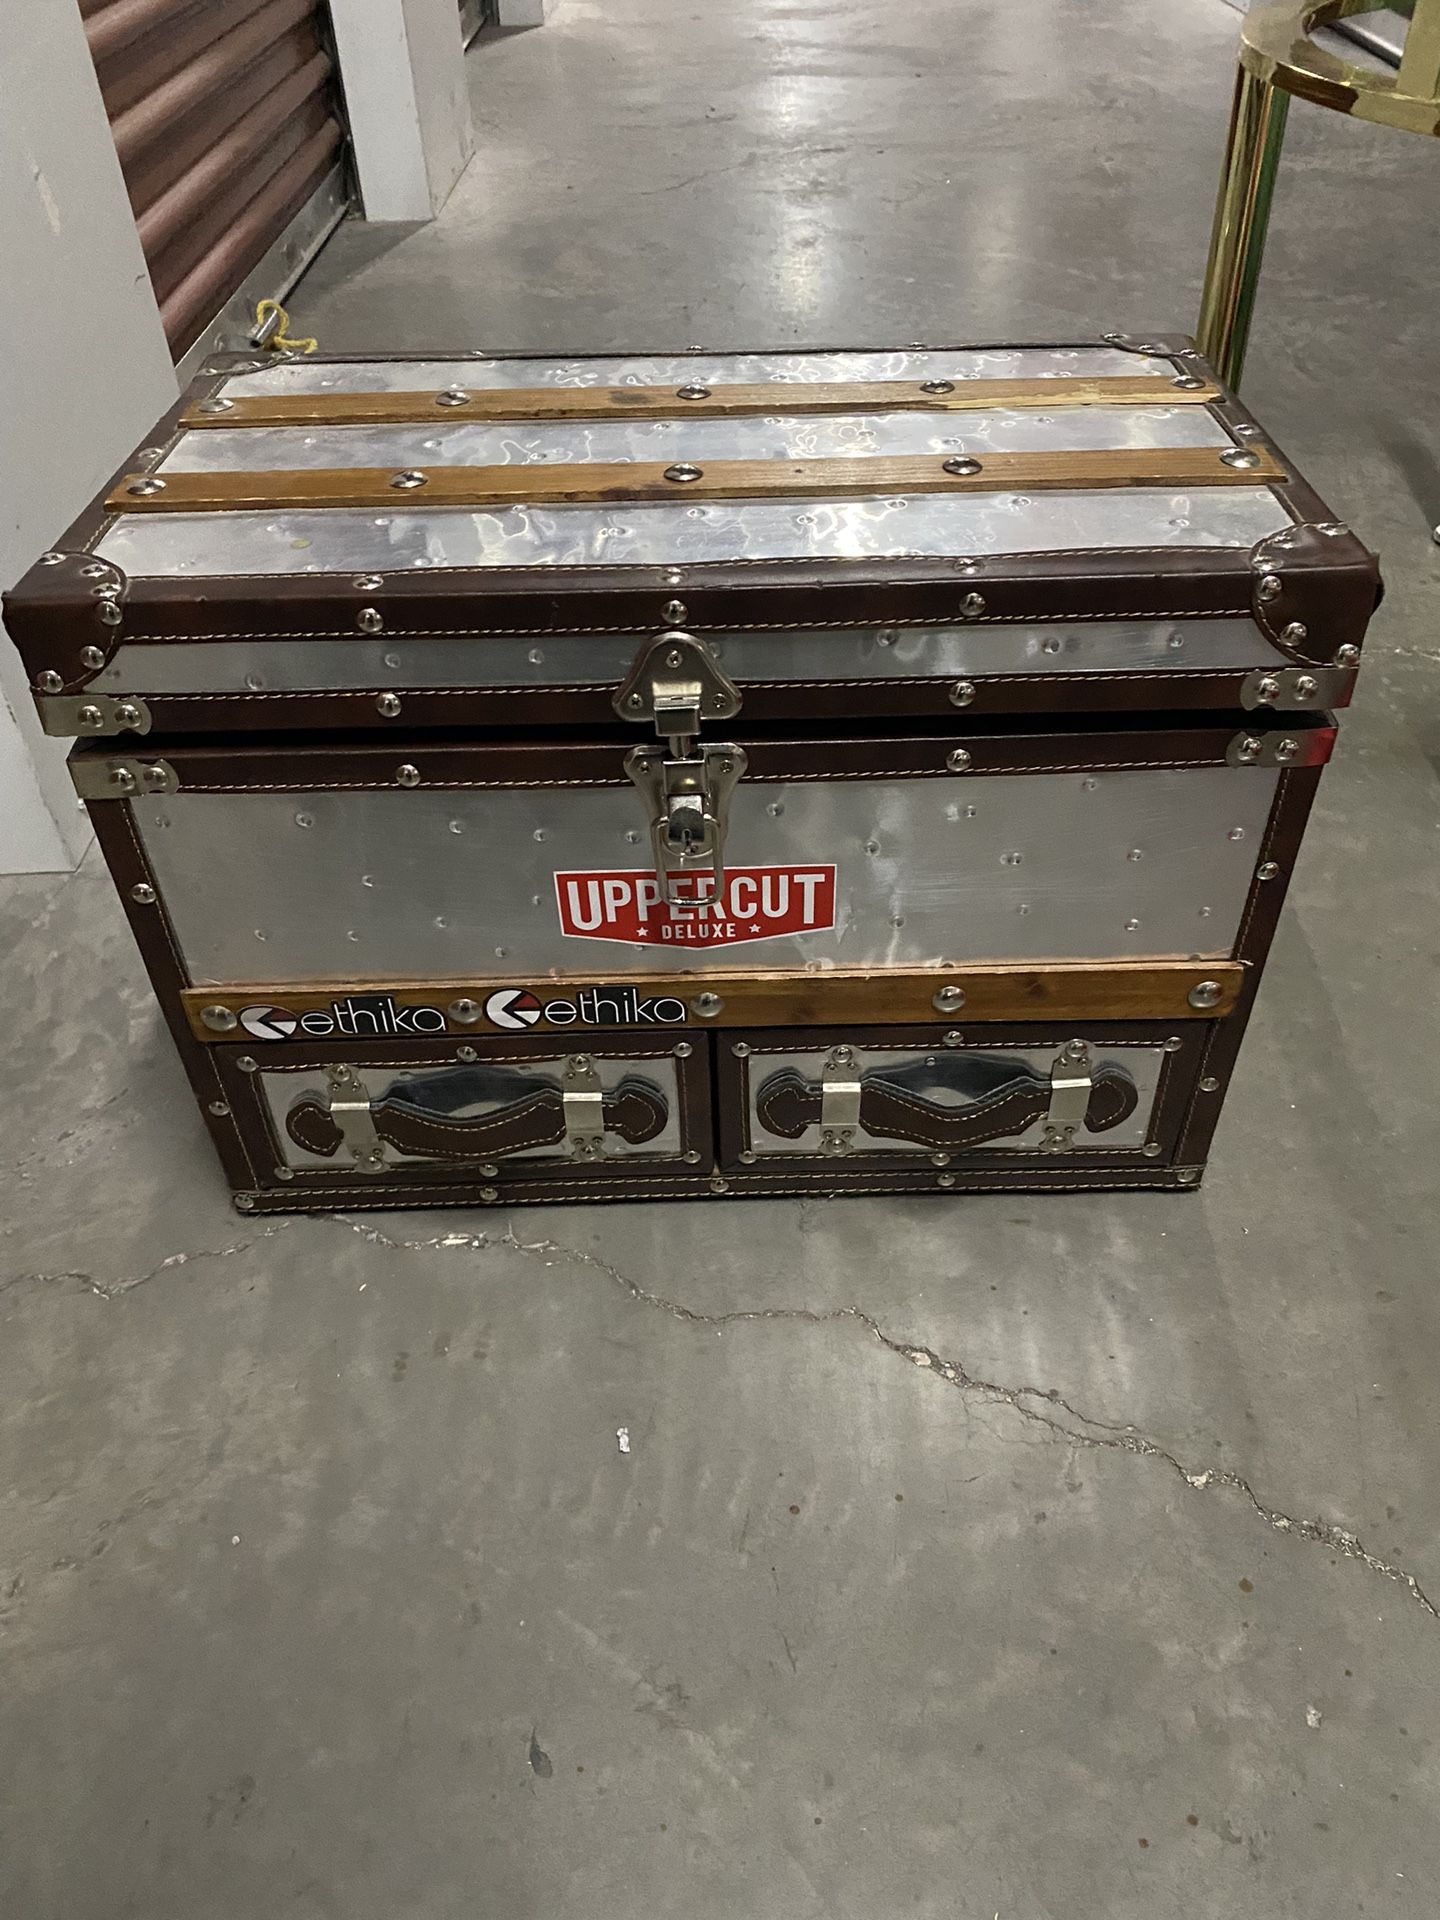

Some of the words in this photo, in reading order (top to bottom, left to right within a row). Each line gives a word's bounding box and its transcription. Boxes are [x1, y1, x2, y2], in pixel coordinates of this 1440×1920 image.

[566, 873, 826, 931] UPPERCUT
[661, 922, 737, 940] DELUXE
[300, 997, 447, 1036] ethika
[544, 988, 686, 1025] ethika
